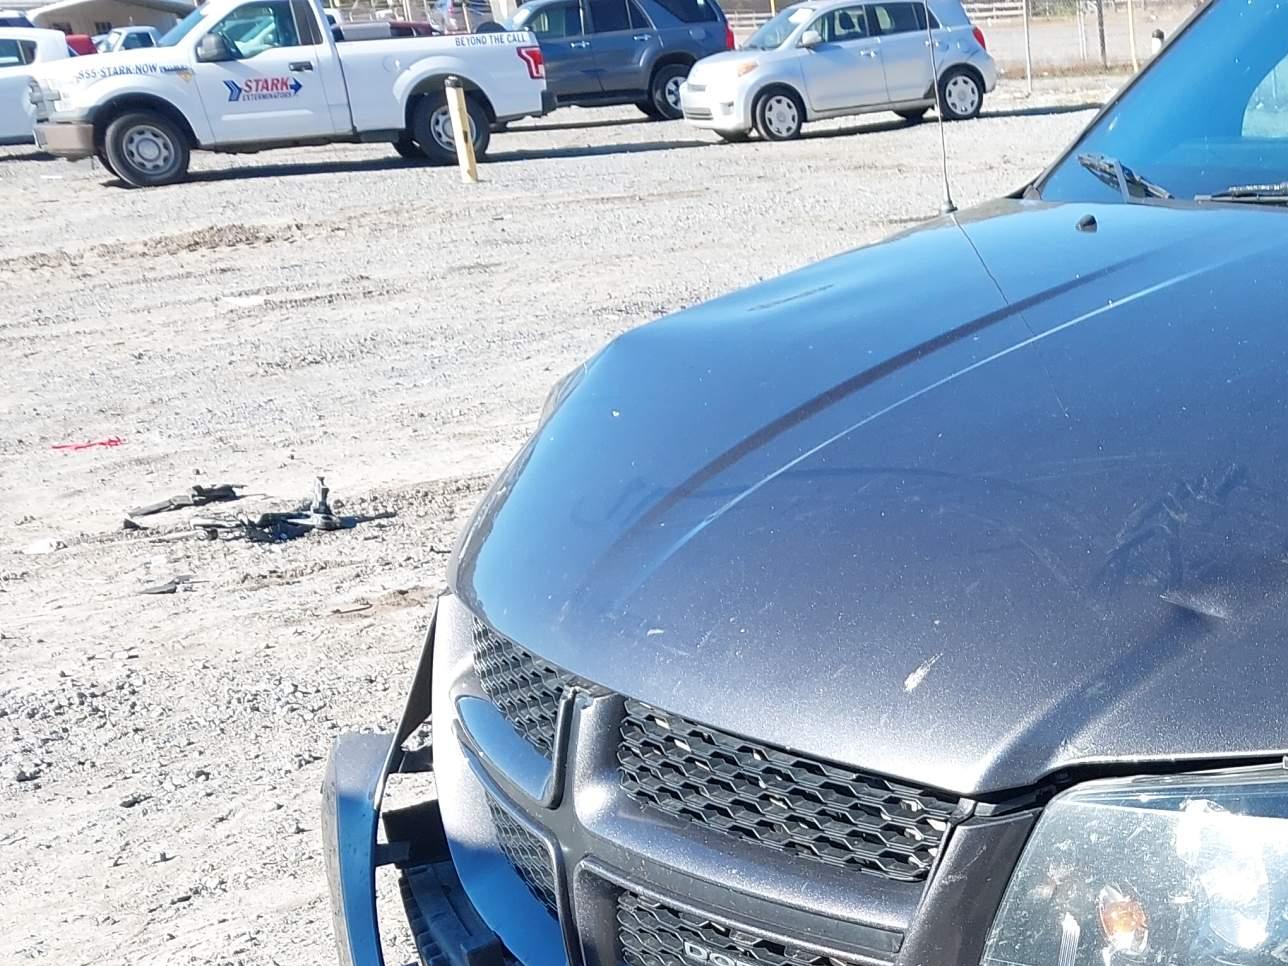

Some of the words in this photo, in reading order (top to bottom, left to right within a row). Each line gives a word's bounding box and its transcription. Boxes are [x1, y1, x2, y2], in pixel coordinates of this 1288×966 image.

[455, 35, 487, 47] BEYOND
[489, 33, 504, 44] THE
[506, 32, 528, 43] CALL
[243, 77, 288, 93] STARK
